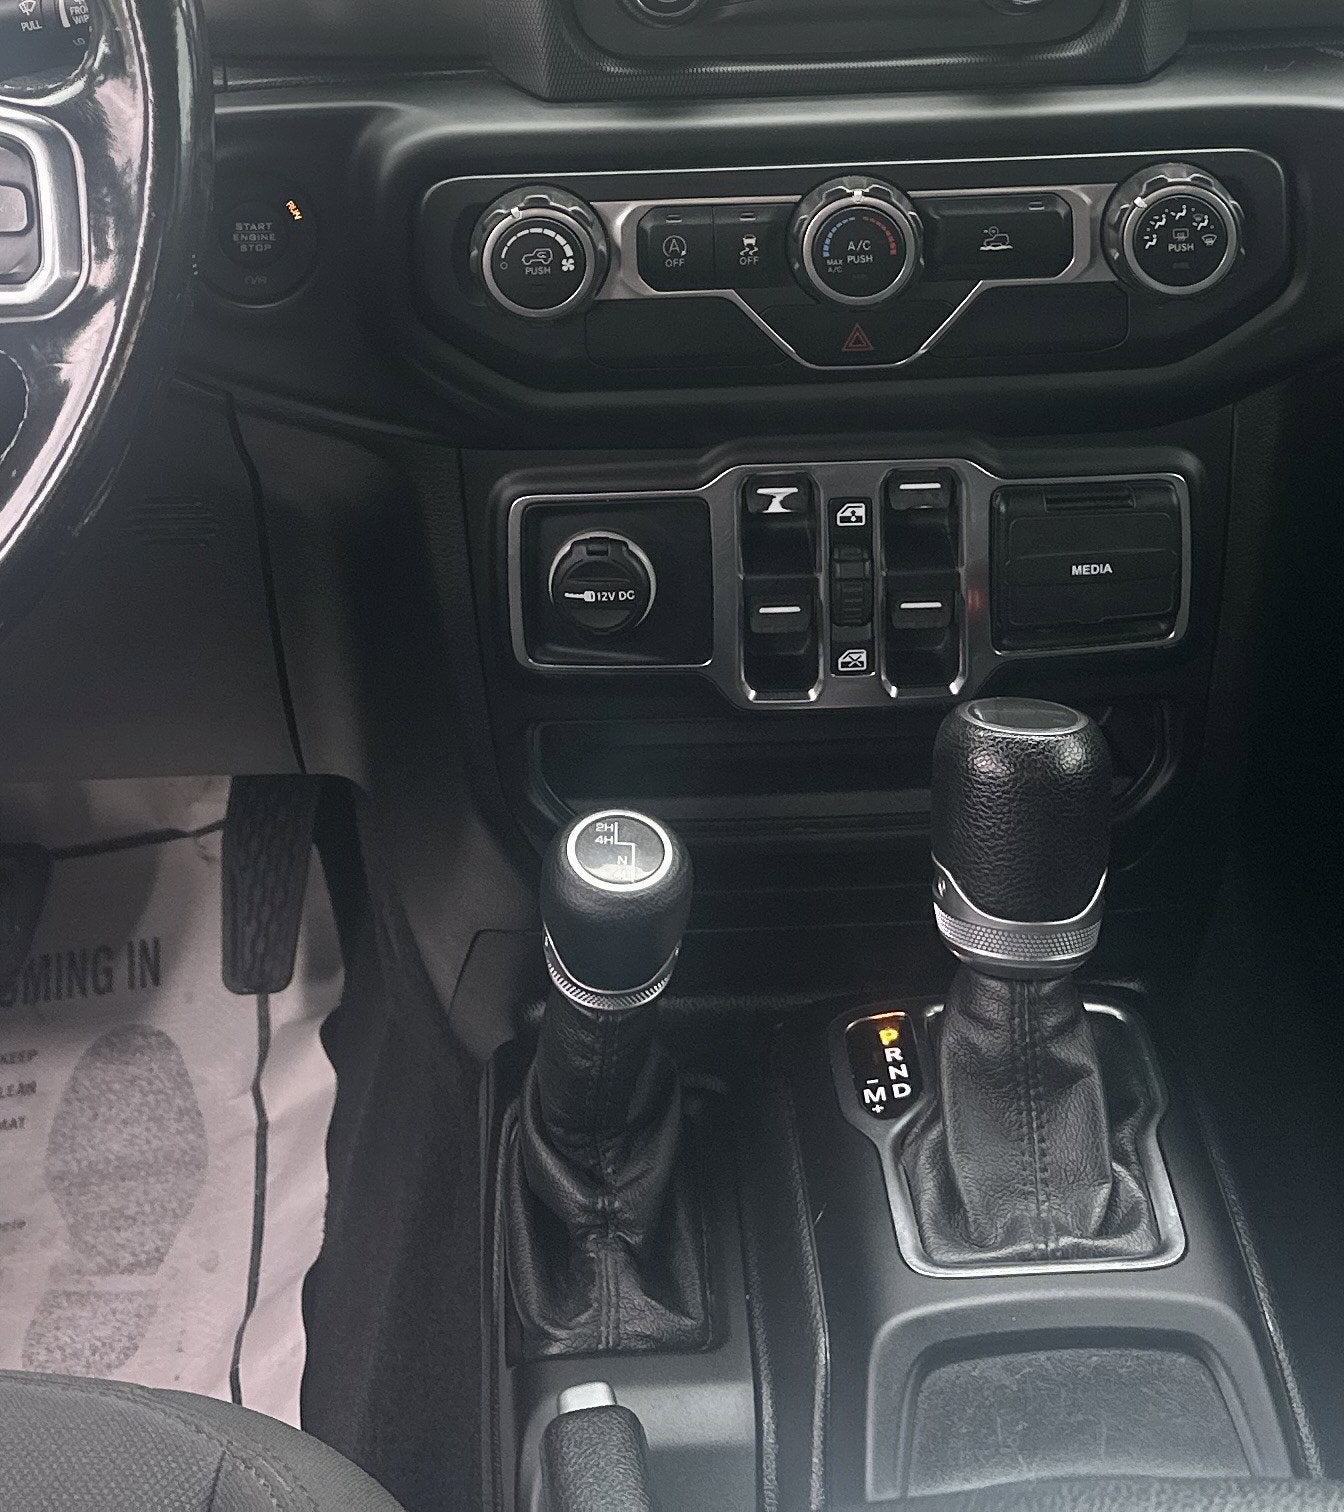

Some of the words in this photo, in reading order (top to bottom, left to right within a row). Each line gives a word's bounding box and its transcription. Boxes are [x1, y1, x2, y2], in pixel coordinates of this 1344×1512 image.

[69, 5, 89, 16] FRO
[21, 20, 42, 31] PULL
[286, 200, 302, 220] RUN
[235, 222, 273, 231] START
[233, 233, 276, 241] ENGINE
[240, 244, 272, 252] STOP
[847, 239, 872, 251] A/C
[1168, 243, 1194, 252] PUSH
[665, 258, 684, 268] OFF
[739, 256, 759, 266] OFF
[847, 254, 873, 264] PUSH
[525, 266, 551, 275] PUSH
[1071, 563, 1113, 576] MEDIA
[596, 591, 616, 601] 12V
[618, 590, 635, 601] DC
[595, 822, 614, 832] 2H
[594, 835, 614, 845] 4H
[617, 855, 628, 865] N
[126, 937, 163, 989] IN
[0, 1049, 38, 1065] KEEP
[884, 1047, 904, 1063] R
[888, 1063, 909, 1080] N
[863, 1086, 887, 1104] M
[892, 1082, 912, 1099] D
